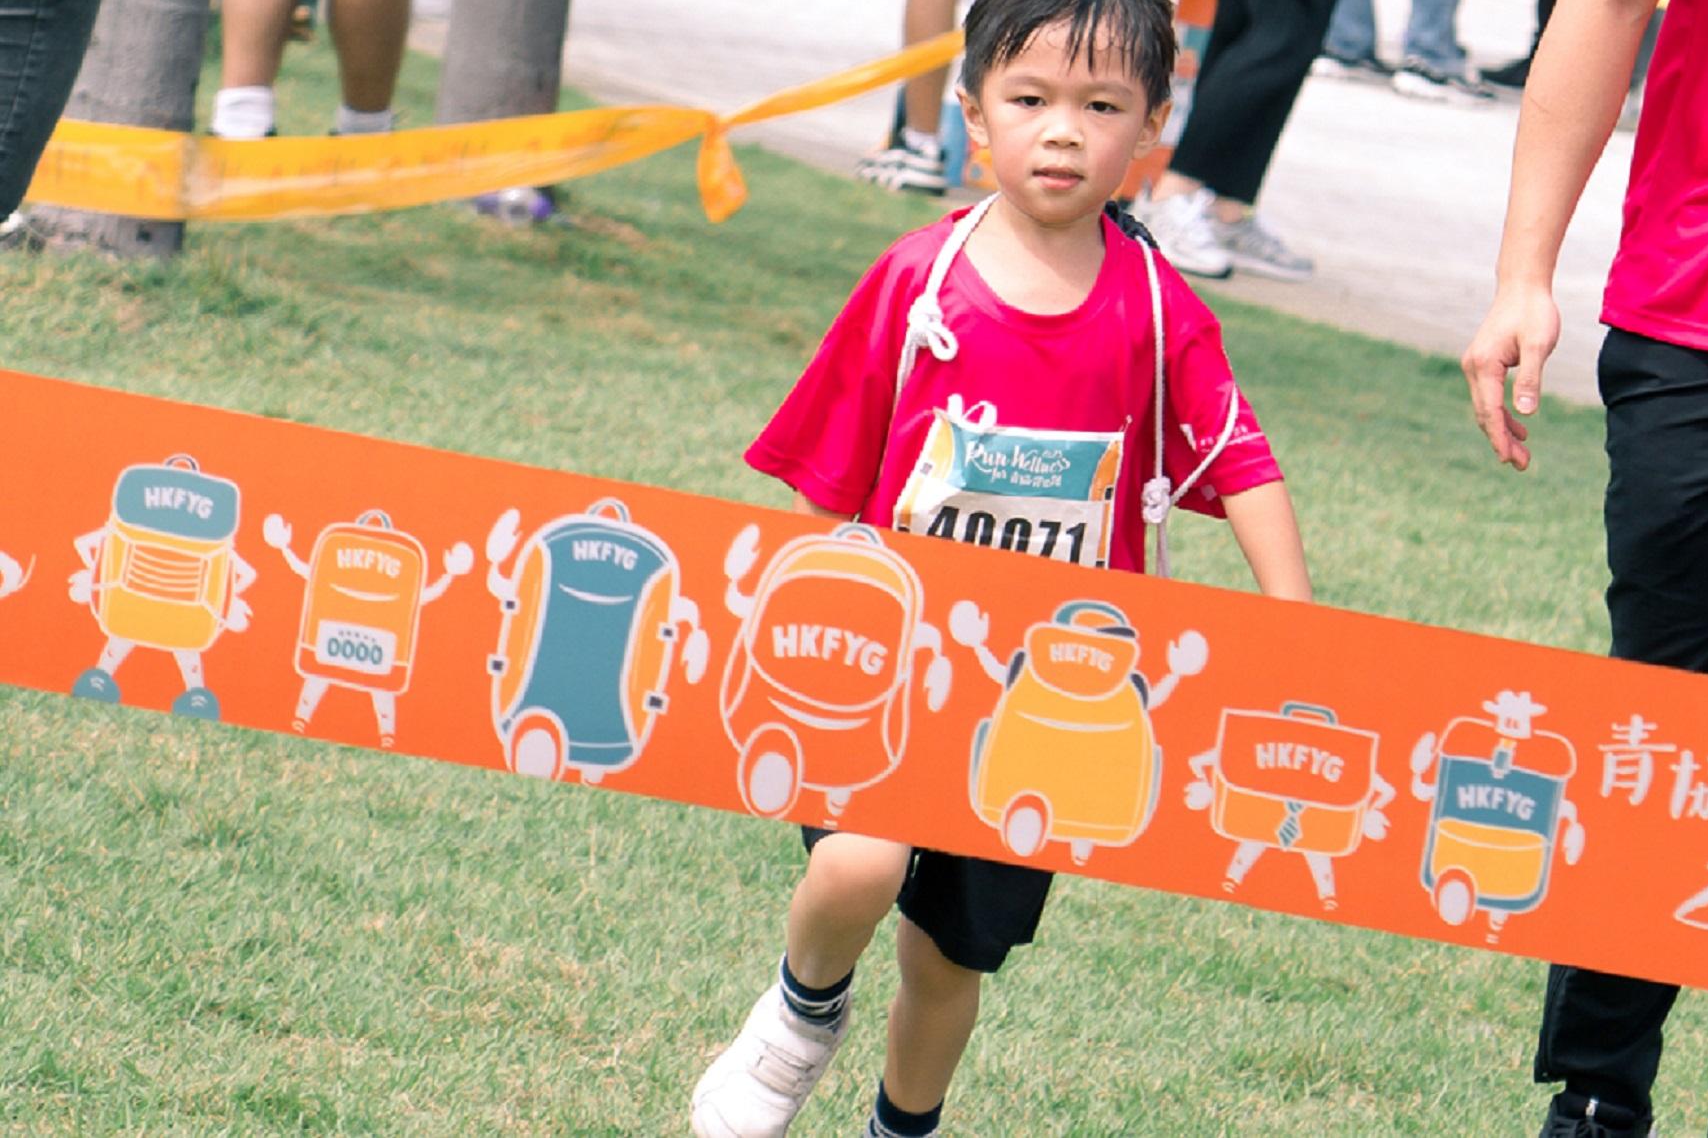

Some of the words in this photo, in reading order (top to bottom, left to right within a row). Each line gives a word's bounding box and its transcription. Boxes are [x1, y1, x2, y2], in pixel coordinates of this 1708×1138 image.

[965, 440, 1007, 473] Run
[1011, 445, 1071, 474] Wellness
[144, 486, 213, 519] HKFYG
[926, 505, 1086, 565] 40071
[337, 548, 402, 579] HKFYG
[572, 541, 638, 570] HKFYG
[327, 638, 383, 665] 0000
[772, 623, 888, 676] HKFYG
[1049, 642, 1115, 673] HKFYG
[1256, 742, 1345, 783] HKFYG
[1458, 784, 1537, 821] HKFYG
